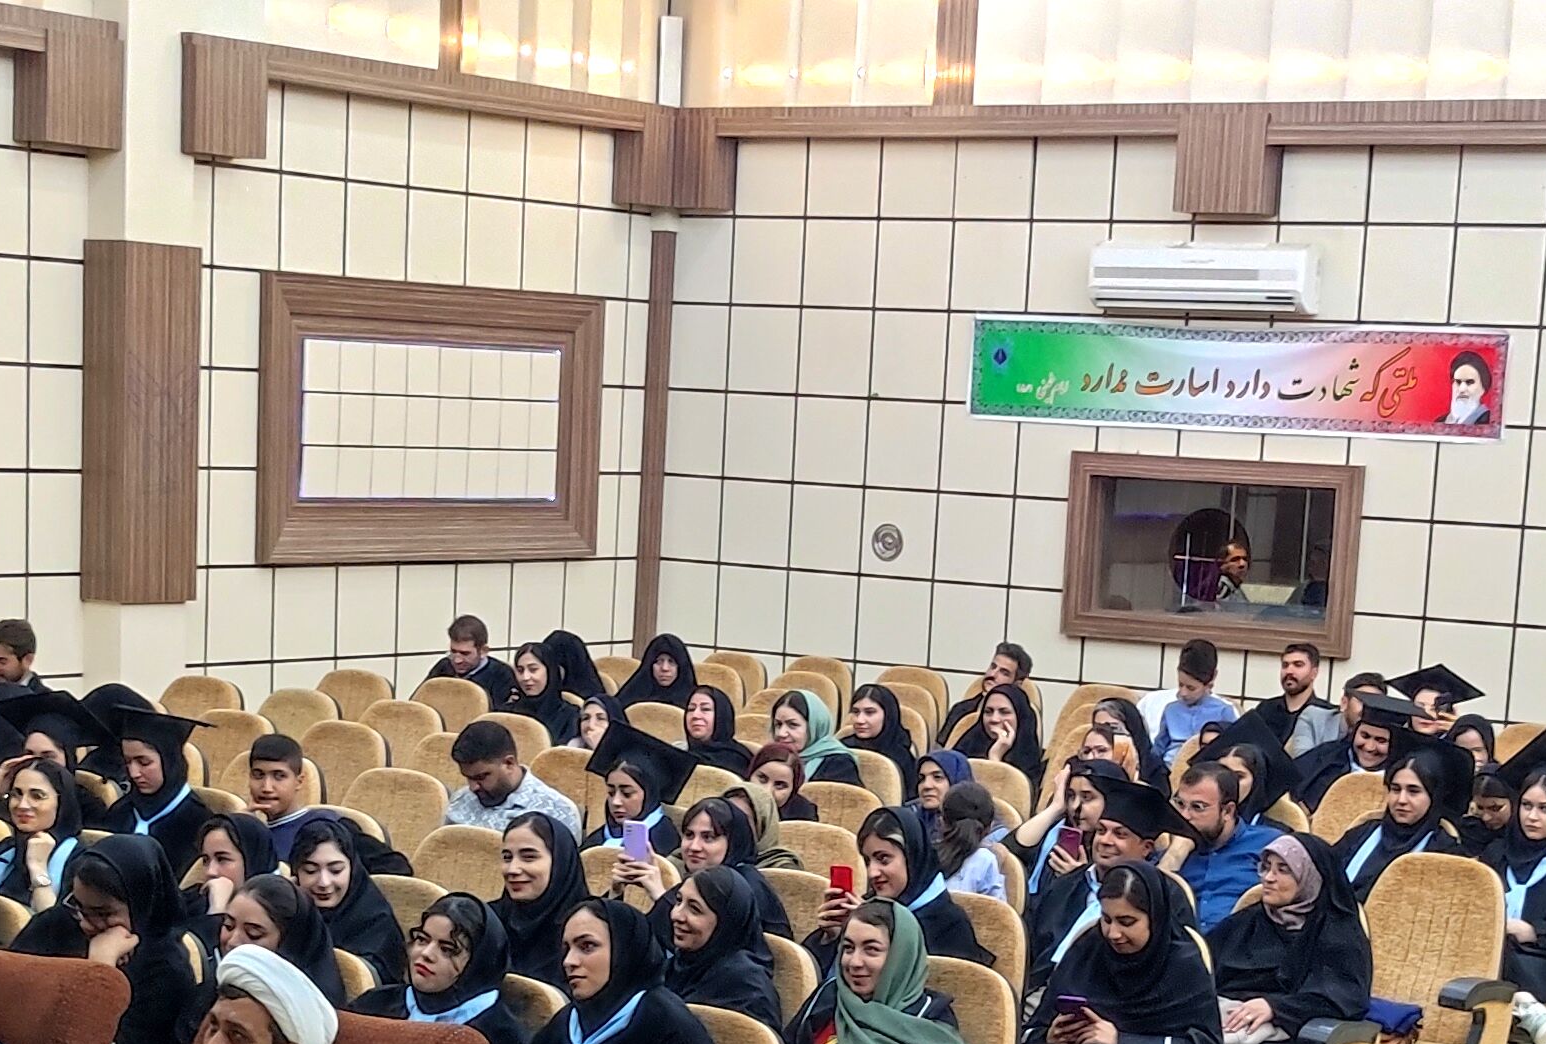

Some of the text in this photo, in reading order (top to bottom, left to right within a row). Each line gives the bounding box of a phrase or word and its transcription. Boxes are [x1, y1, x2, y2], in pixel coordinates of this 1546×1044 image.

[1080, 361, 1128, 394] ندارد
[1134, 366, 1220, 398] اسارت
[1223, 368, 1271, 399] دارد
[1277, 357, 1360, 402] شهادت
[1359, 346, 1411, 403] که
[1376, 366, 1418, 418] ملتی
